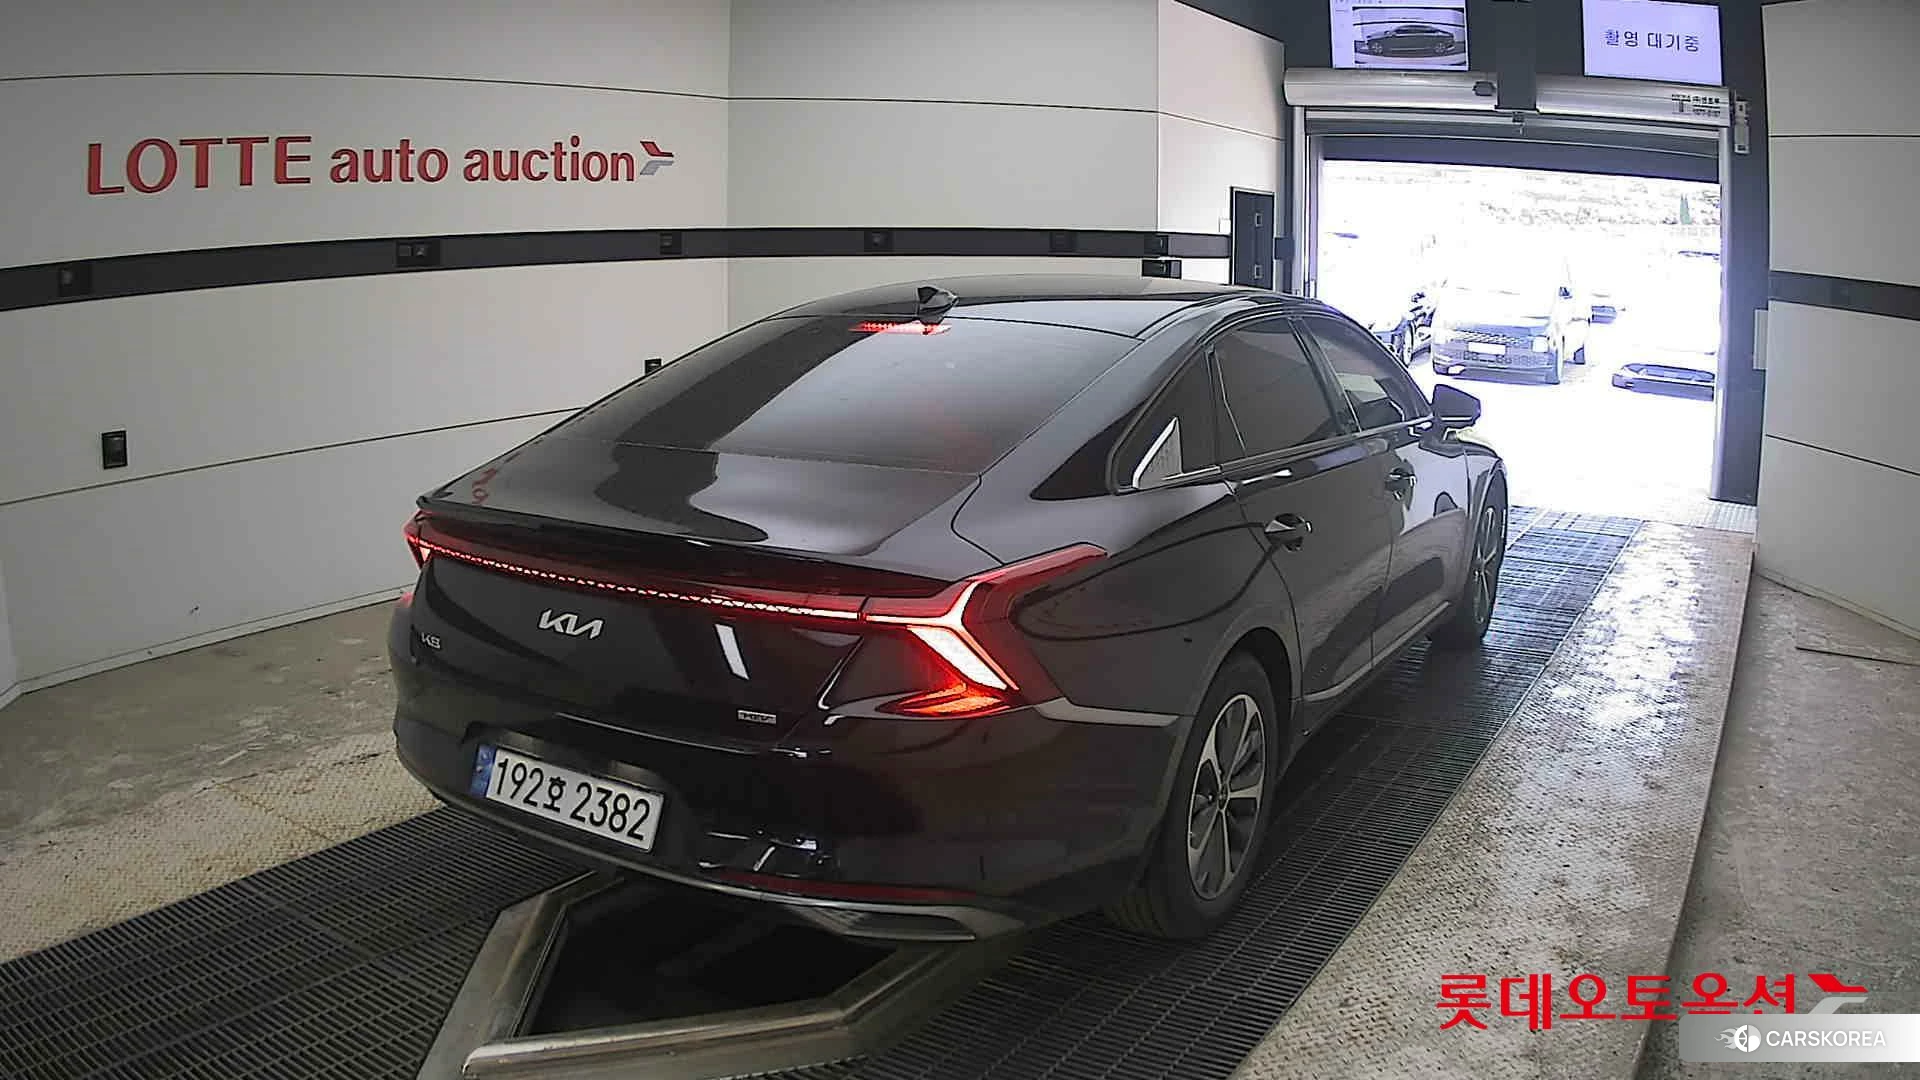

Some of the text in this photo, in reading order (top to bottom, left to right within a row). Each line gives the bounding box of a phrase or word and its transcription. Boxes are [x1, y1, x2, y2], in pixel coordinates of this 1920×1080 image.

[86, 135, 636, 196] LOTTE auto auction
